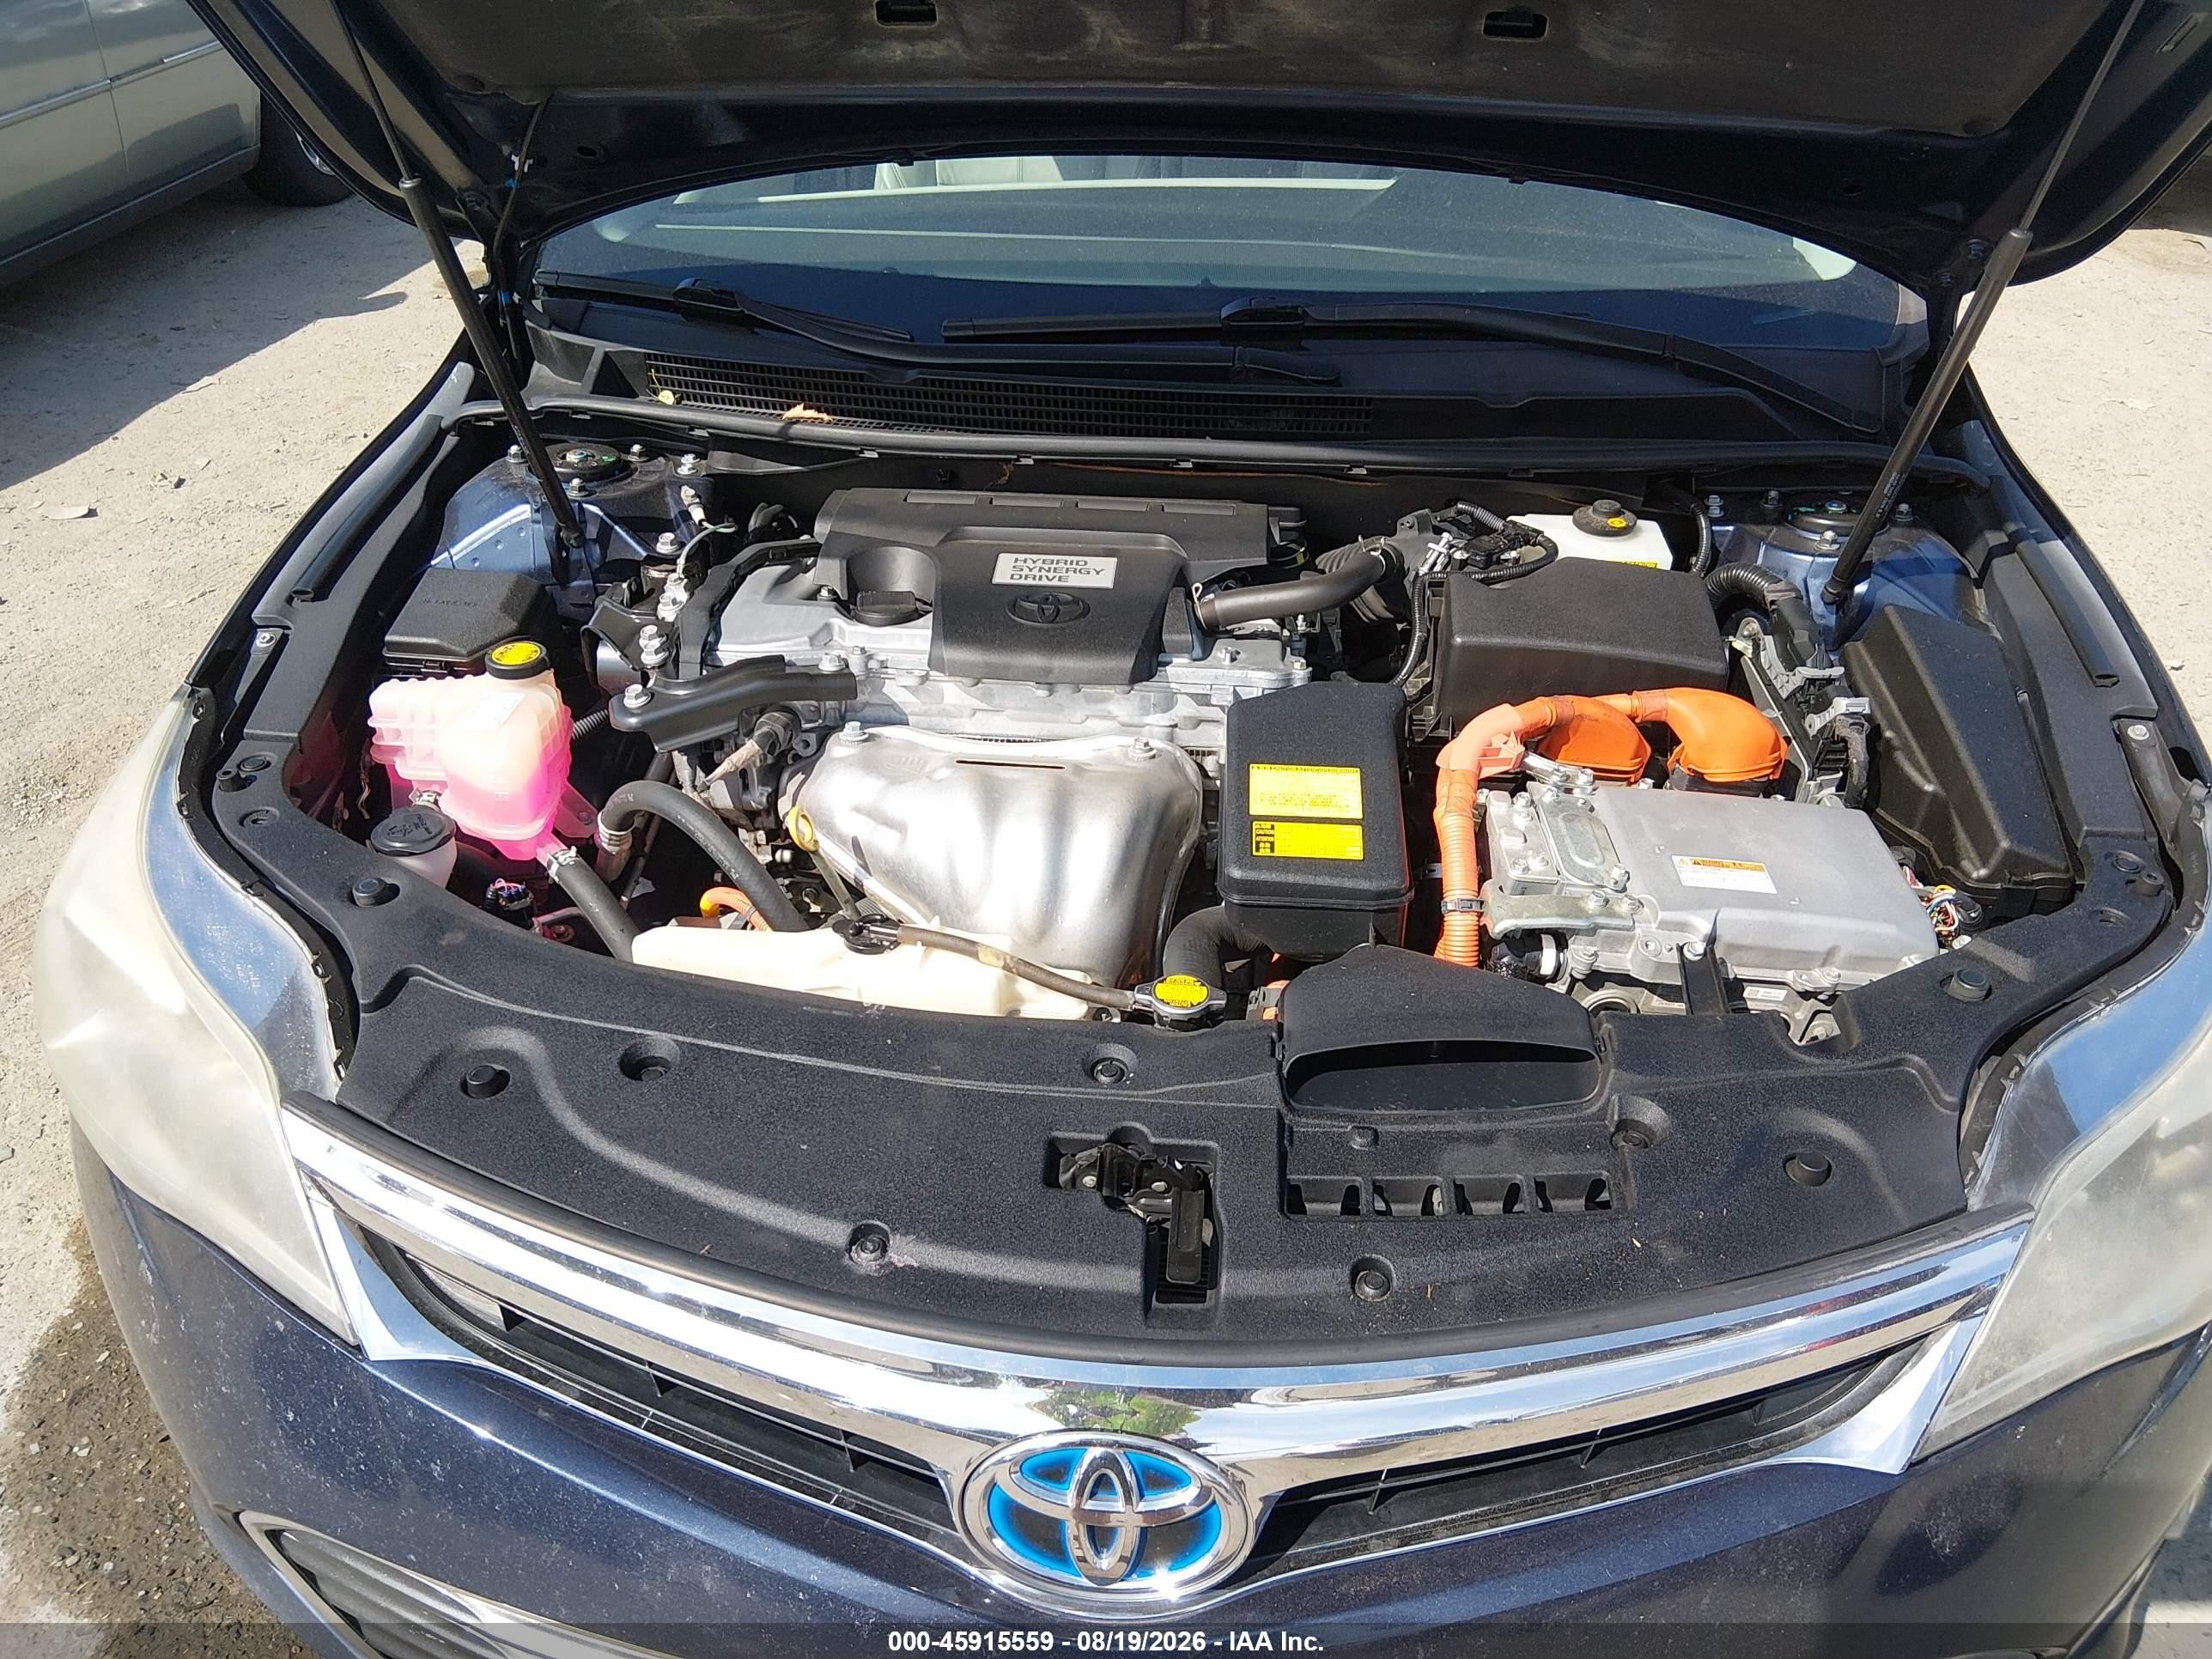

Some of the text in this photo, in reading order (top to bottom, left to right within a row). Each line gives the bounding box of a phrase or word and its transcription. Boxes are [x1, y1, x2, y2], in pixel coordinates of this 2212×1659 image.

[1013, 557, 1088, 566] HYBRID
[1012, 565, 1104, 575] SYNERGY
[1010, 573, 1070, 582] DRIVE
